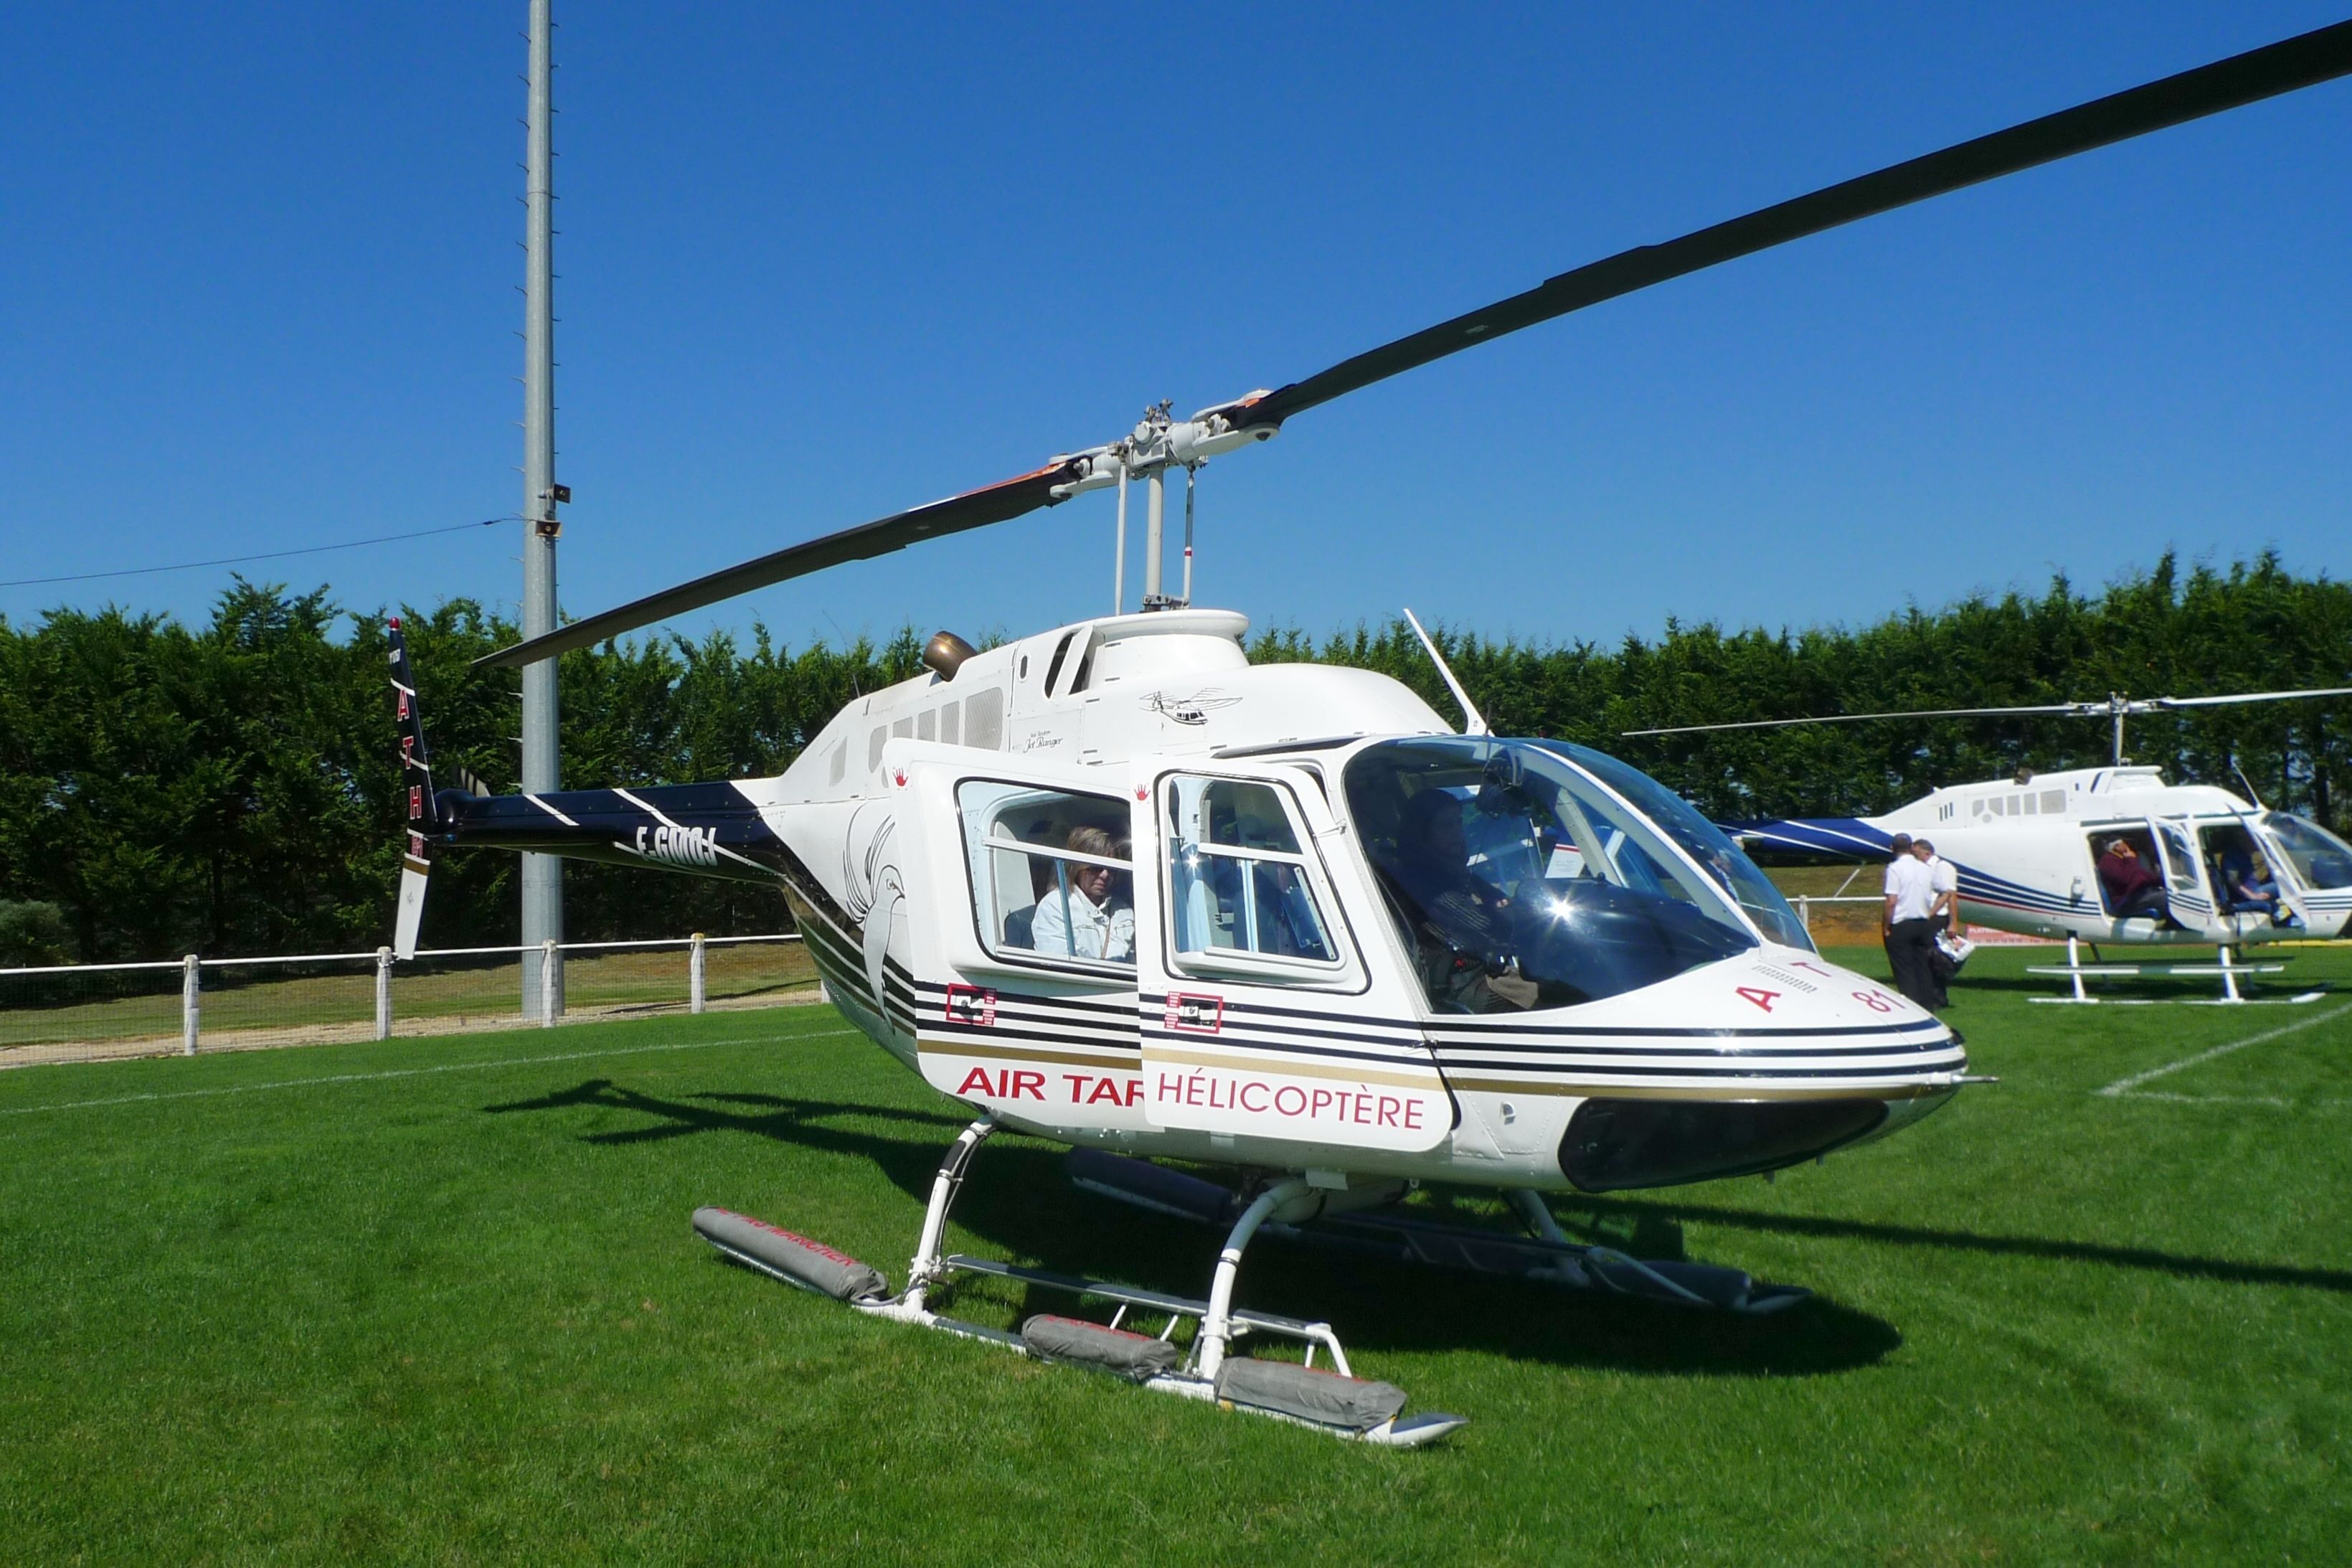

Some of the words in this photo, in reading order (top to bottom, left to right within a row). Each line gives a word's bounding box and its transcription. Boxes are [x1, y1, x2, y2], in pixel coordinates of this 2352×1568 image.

[1735, 986, 1782, 1014] A
[1851, 989, 1906, 1012] 81
[956, 1067, 1045, 1100] AIR
[1158, 1068, 1425, 1130] HÉLICOPTÈRE
